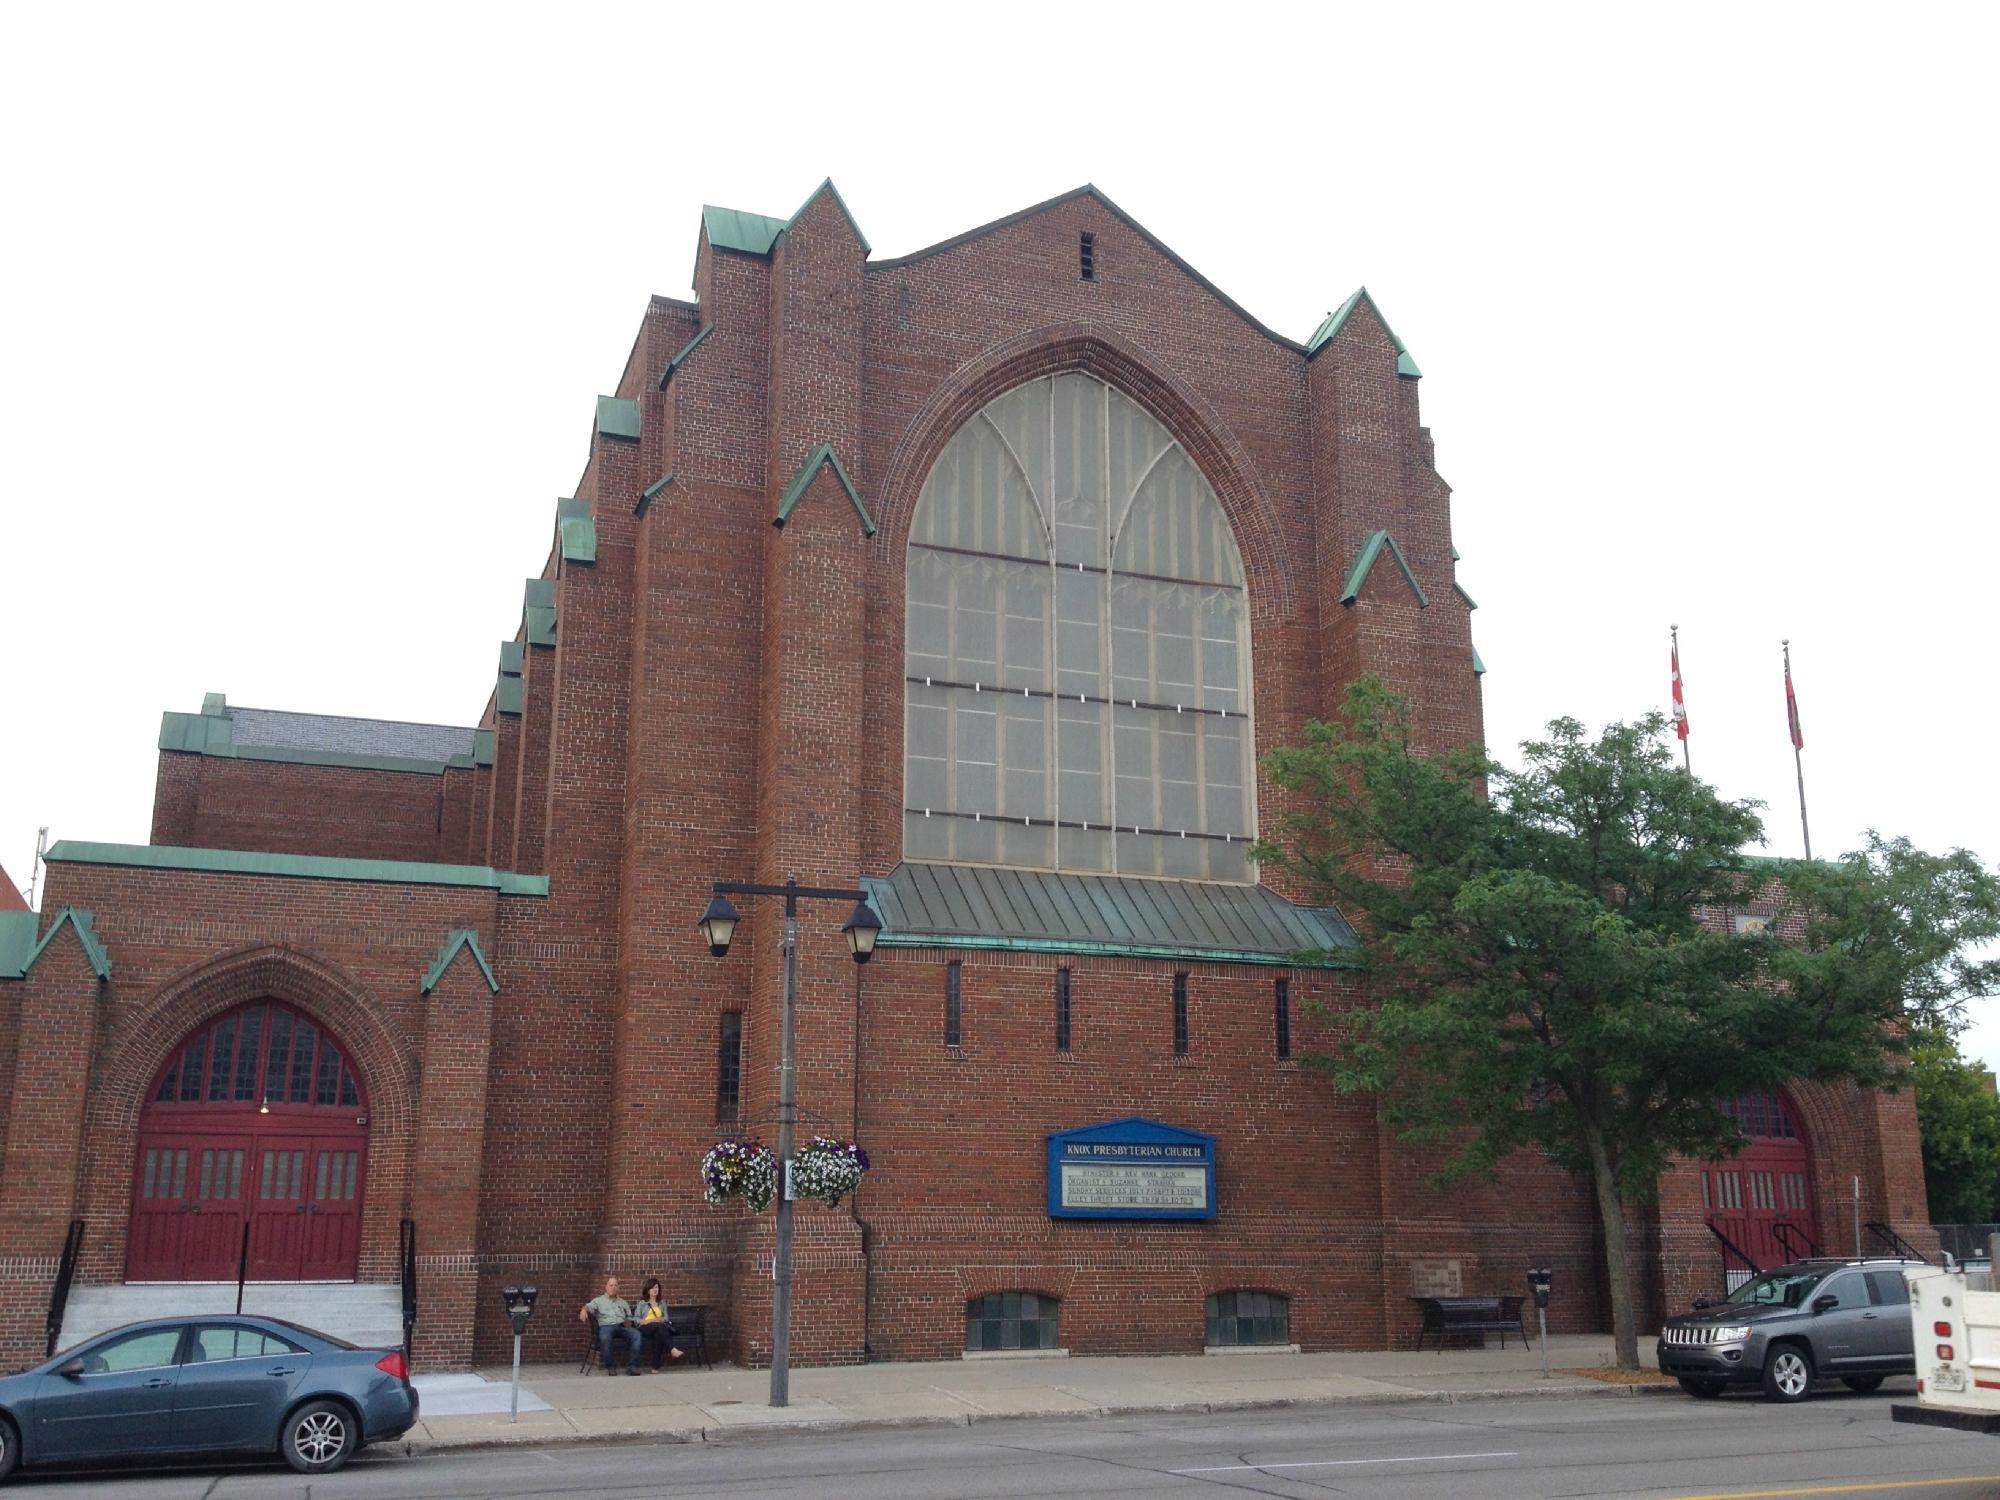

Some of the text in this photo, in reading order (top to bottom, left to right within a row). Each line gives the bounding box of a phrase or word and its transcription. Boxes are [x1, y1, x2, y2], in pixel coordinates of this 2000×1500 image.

[1067, 1144, 1201, 1157] KNOX PRESBYTERIAN CHURCH
